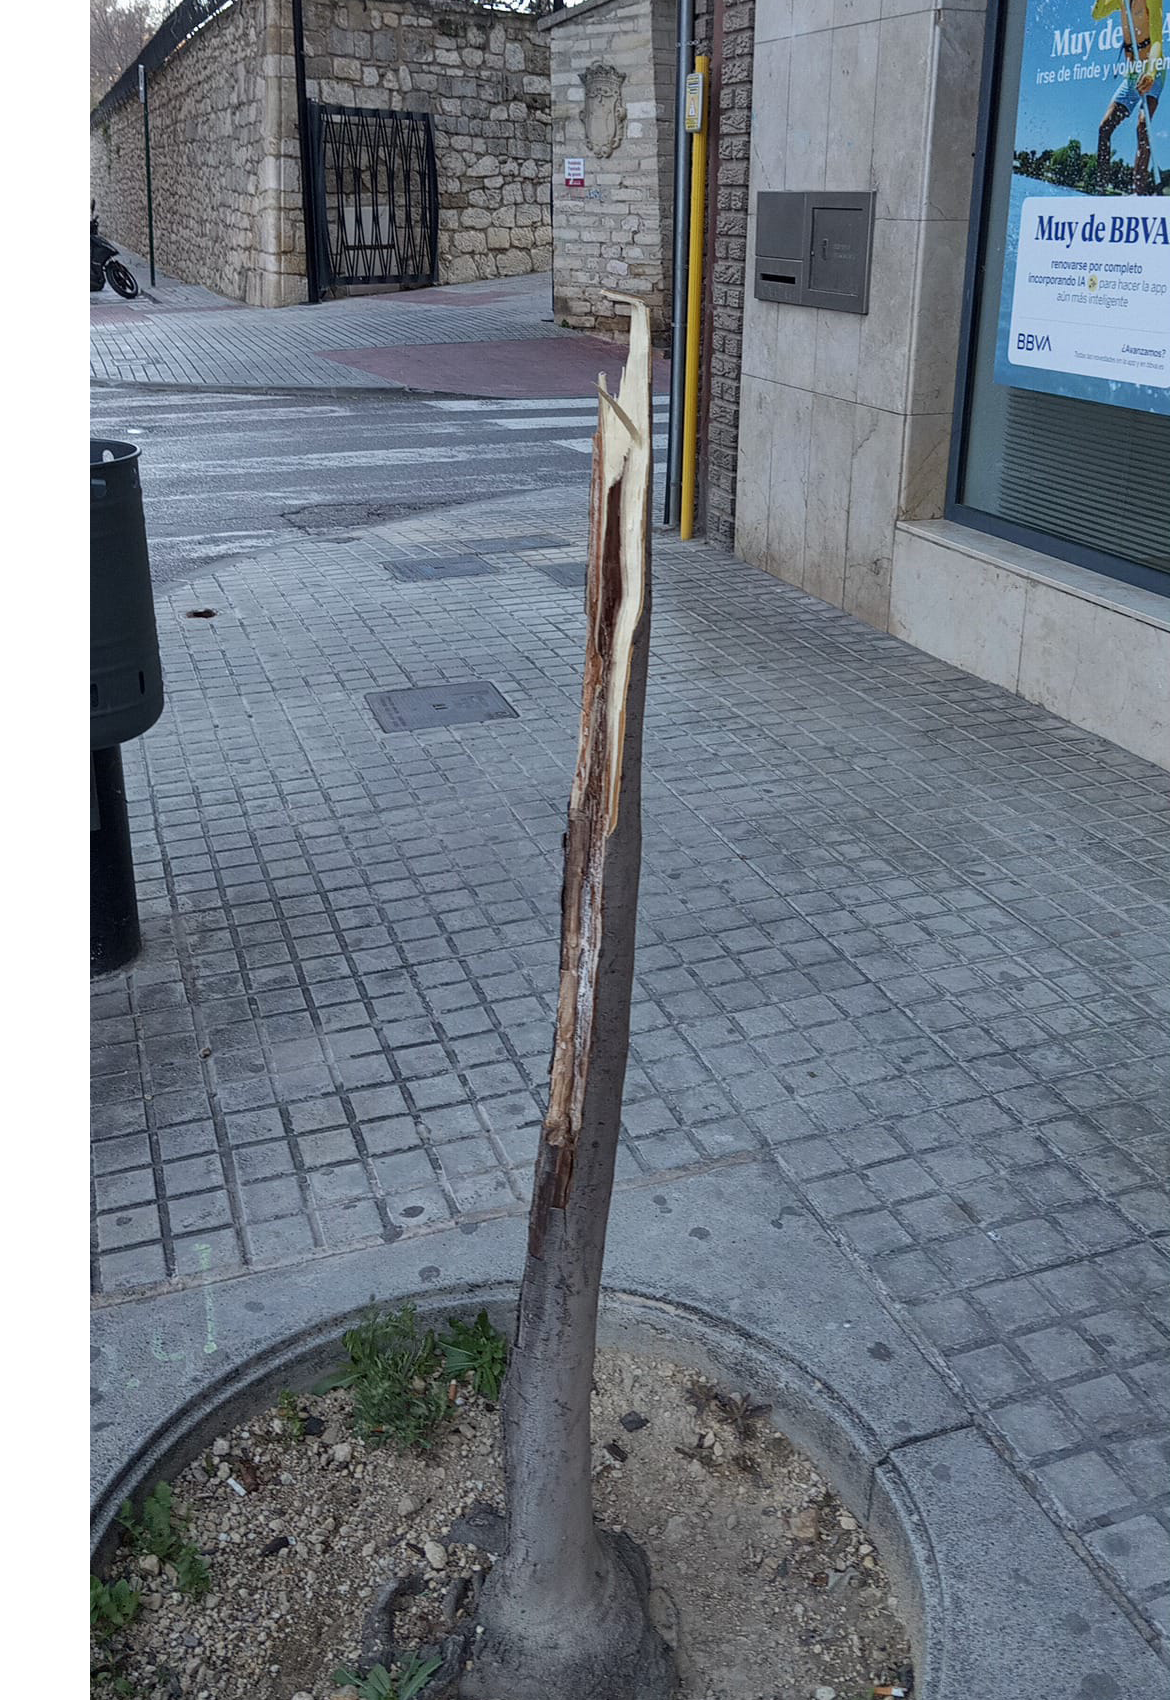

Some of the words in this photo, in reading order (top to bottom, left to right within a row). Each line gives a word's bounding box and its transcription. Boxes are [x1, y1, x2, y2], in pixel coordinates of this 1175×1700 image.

[1050, 28, 1097, 60] Muy
[1098, 19, 1124, 50] de
[1036, 68, 1055, 84] irse
[1057, 66, 1070, 82] de
[1073, 61, 1100, 80] finde
[1102, 64, 1111, 81] y
[1113, 58, 1147, 75] volver
[1034, 215, 1079, 248] Muy
[1081, 213, 1106, 243] de
[1109, 216, 1170, 245] BBVA
[1051, 259, 1087, 271] renovarse
[1088, 262, 1102, 273] por
[1104, 262, 1143, 274] completo
[1028, 272, 1076, 287] incorporando
[1078, 276, 1086, 287] IA
[1099, 279, 1117, 291] para
[1118, 279, 1140, 291] hacer
[1141, 280, 1149, 292] la
[1150, 283, 1167, 296] app
[1056, 291, 1071, 302] aún
[1071, 291, 1088, 304] más
[1088, 293, 1129, 309] inteligente
[1017, 333, 1052, 351] BBVA
